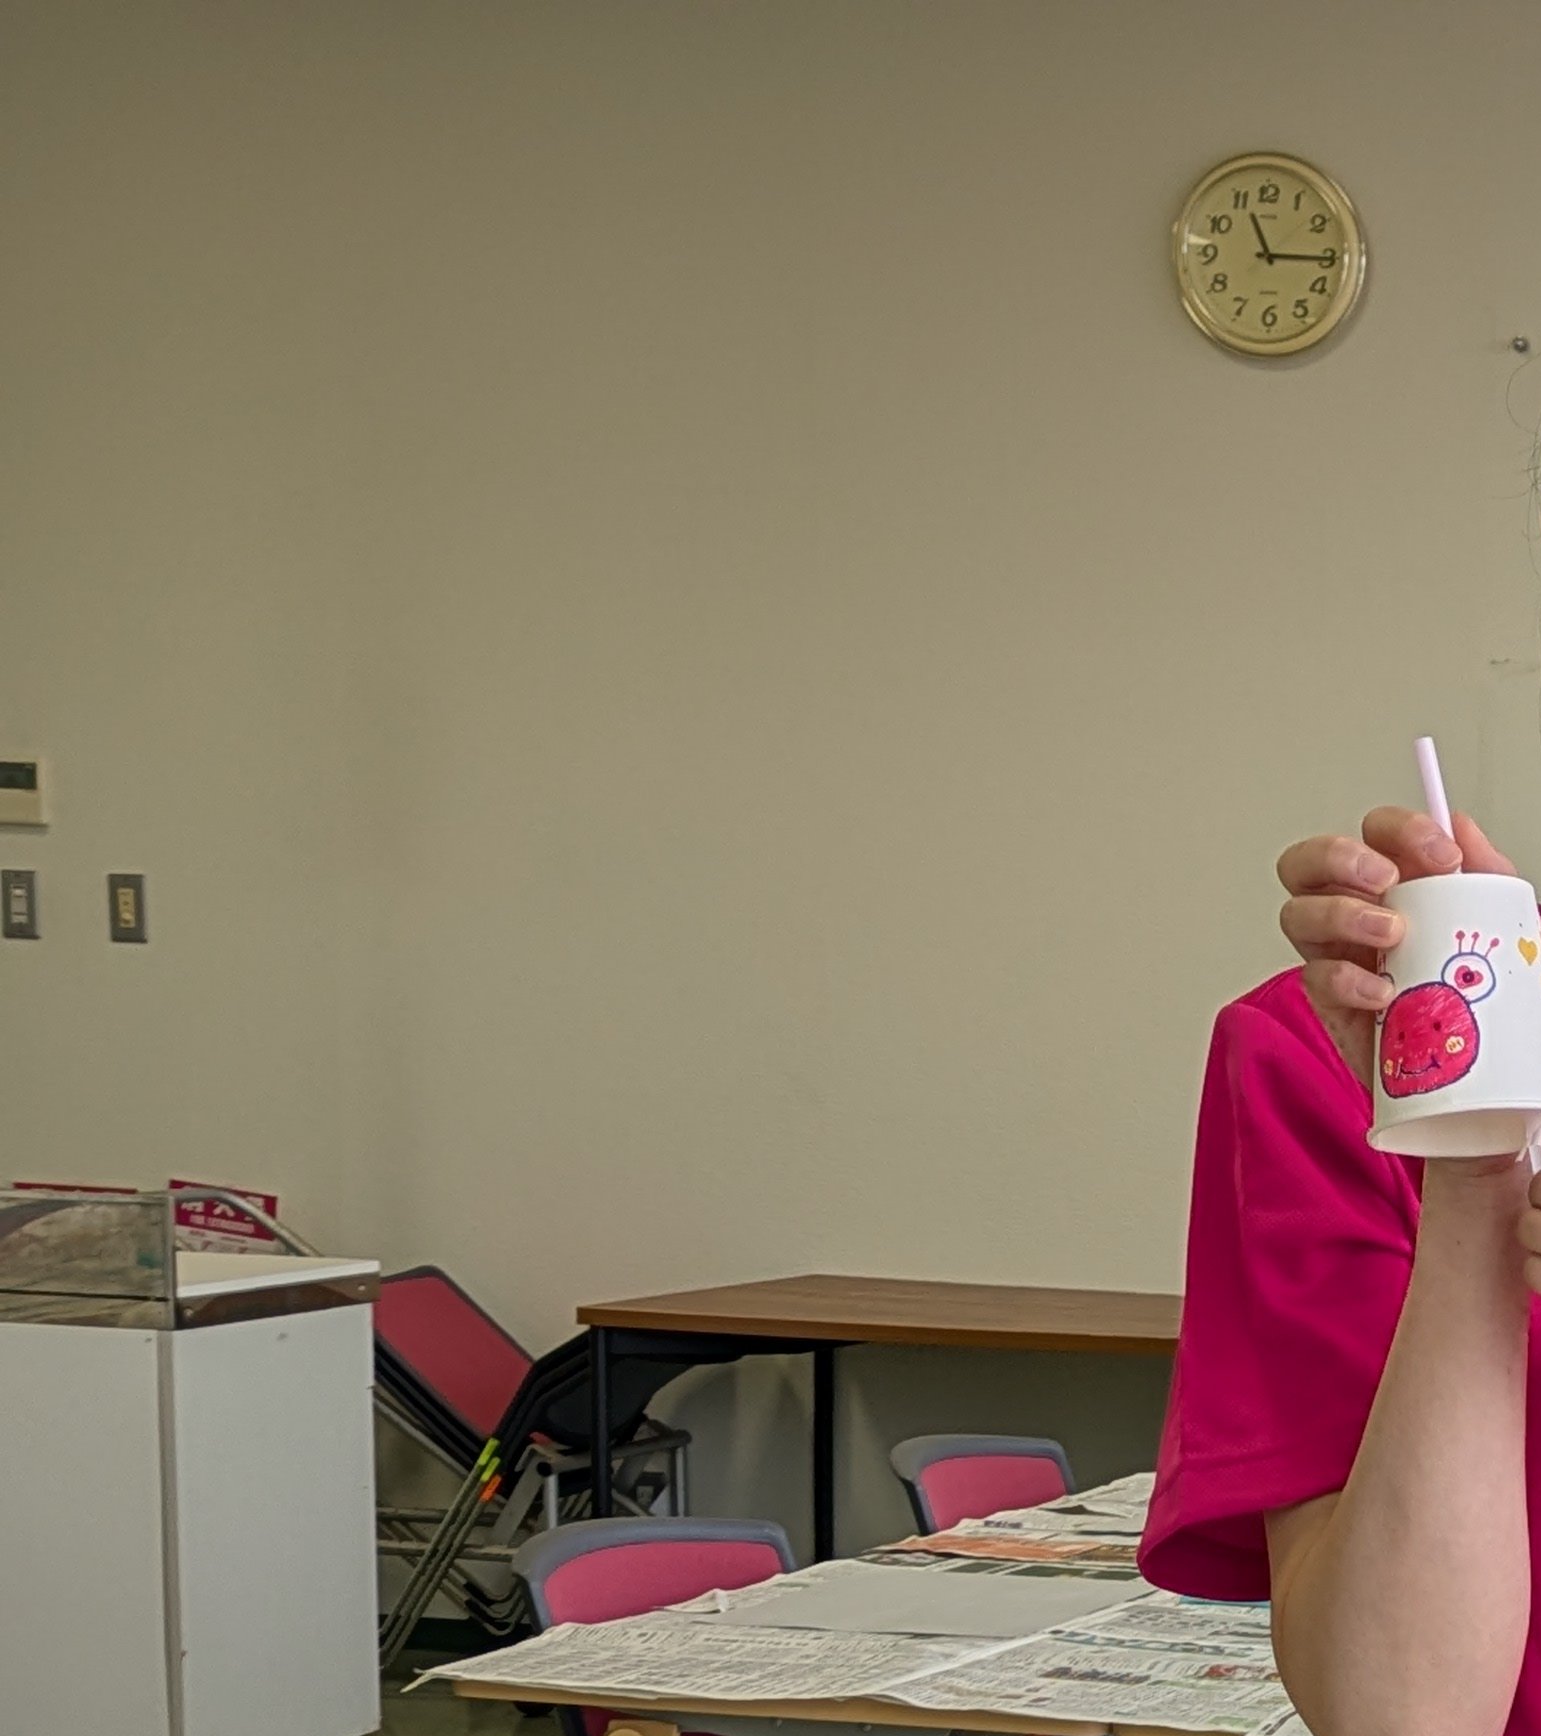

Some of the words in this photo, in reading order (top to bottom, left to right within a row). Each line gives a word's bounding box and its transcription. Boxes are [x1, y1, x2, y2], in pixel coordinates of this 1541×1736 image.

[1233, 190, 1249, 209] 11
[1258, 183, 1280, 203] 12
[1293, 191, 1303, 210] 1
[1209, 214, 1232, 234] 10
[1310, 214, 1327, 233] 2
[1201, 244, 1218, 265] 9
[1318, 247, 1336, 268] 3
[1210, 273, 1228, 292] 8
[1309, 275, 1327, 294] 4
[1233, 296, 1248, 317] 7
[1261, 305, 1277, 326] 6
[1292, 299, 1309, 318] 5
